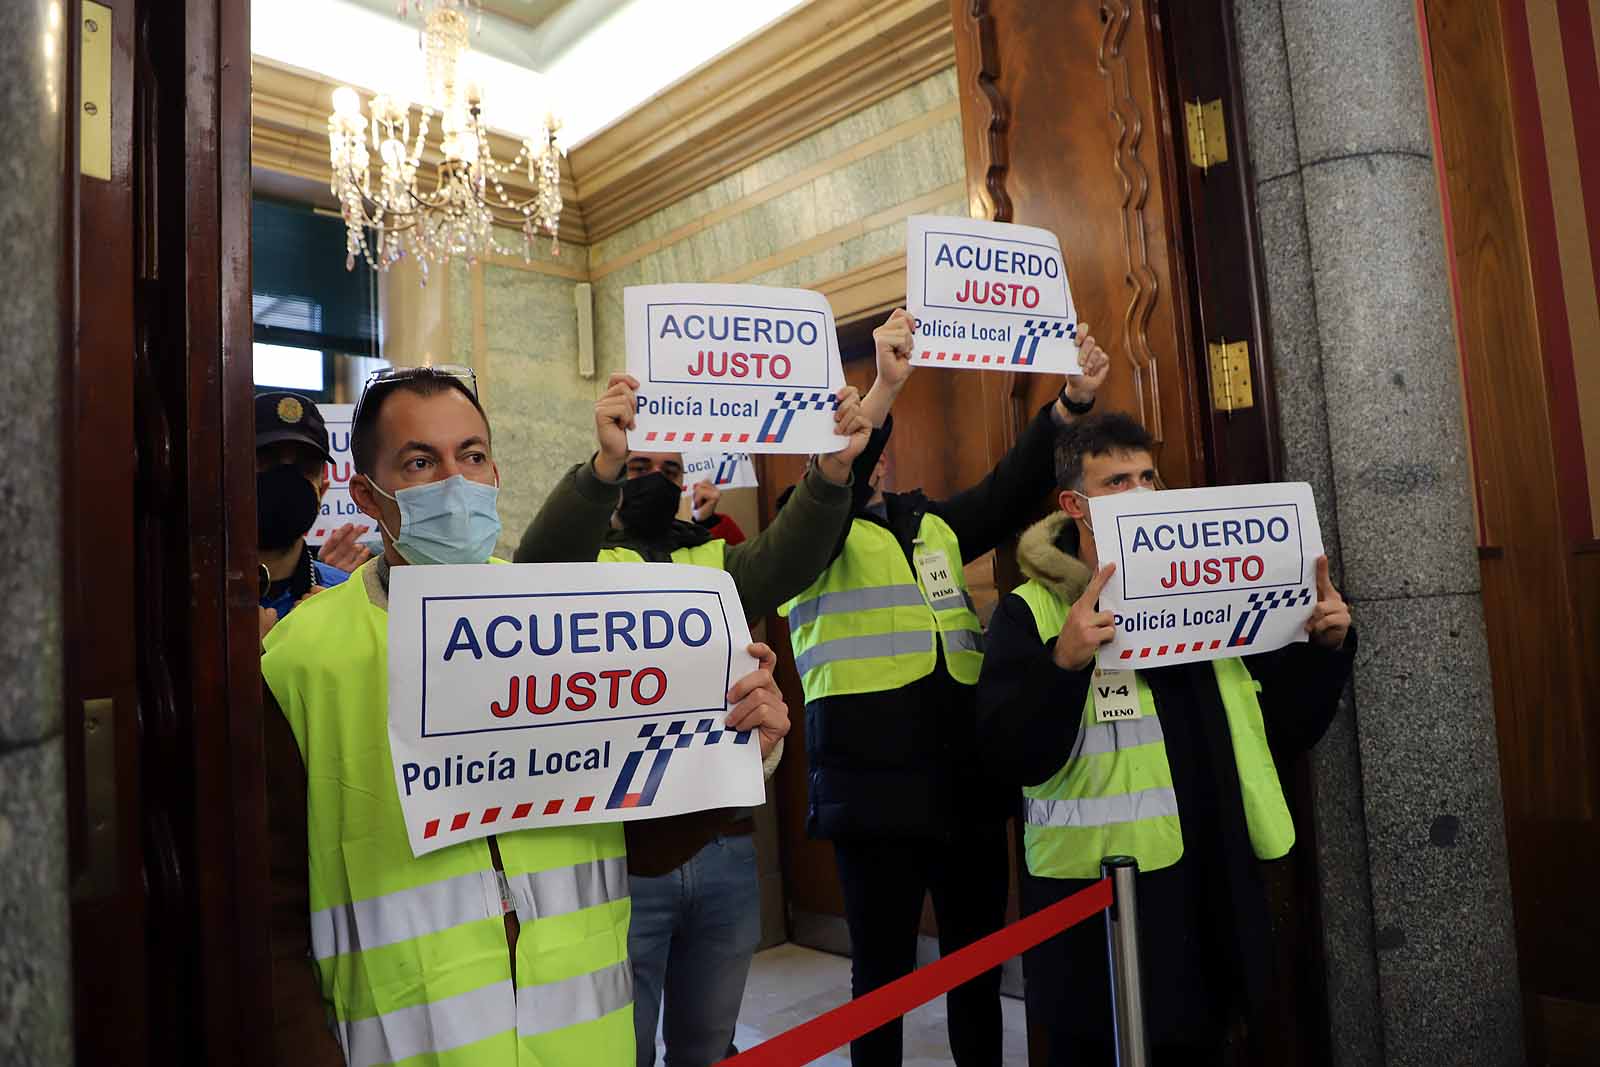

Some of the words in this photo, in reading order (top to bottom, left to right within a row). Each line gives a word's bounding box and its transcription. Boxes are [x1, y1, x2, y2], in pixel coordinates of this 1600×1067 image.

[935, 243, 1058, 279] ACUERDO
[956, 279, 1040, 309] JUSTO
[659, 314, 818, 346] ACUERDO
[911, 318, 966, 339] Policía
[971, 322, 1011, 342] Local
[687, 350, 792, 380] JUSTO
[636, 396, 703, 416] Policía
[709, 398, 759, 418] Local
[682, 457, 715, 475] ocal
[1131, 516, 1289, 553] ACUERDO
[1160, 555, 1265, 589] JUSTO
[1113, 608, 1176, 633] Policía
[1183, 604, 1231, 626] Local
[443, 607, 712, 661] ACUERDO
[490, 667, 668, 718] JUSTO
[1097, 684, 1129, 698] V-4
[1102, 707, 1134, 718] PLENO
[402, 750, 516, 796] Policía
[528, 741, 611, 777] Local
